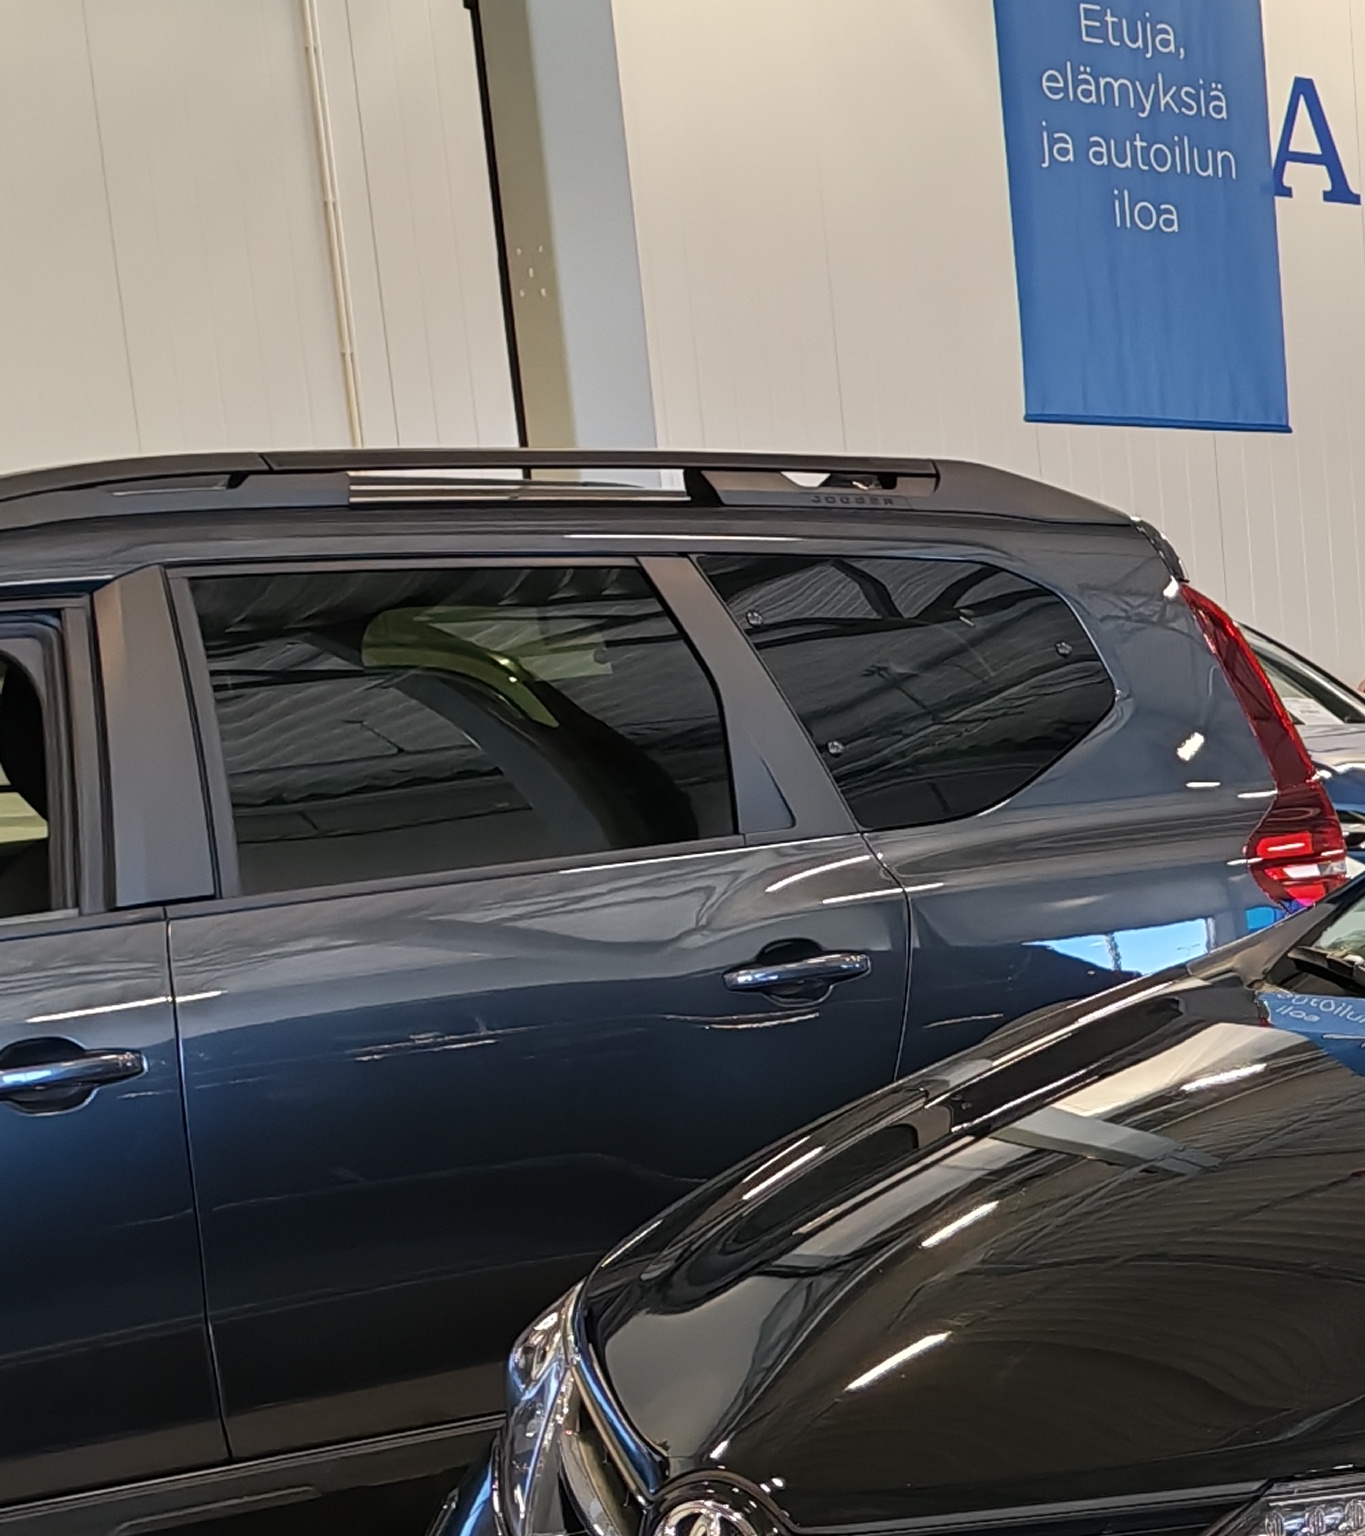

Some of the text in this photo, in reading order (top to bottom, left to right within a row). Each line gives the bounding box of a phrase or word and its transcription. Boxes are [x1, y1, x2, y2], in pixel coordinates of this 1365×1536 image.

[1078, 2, 1186, 60] Etuja,
[1041, 60, 1228, 120] elämyksiä
[1040, 120, 1237, 180] ja autoilun
[1112, 188, 1180, 233] iloa
